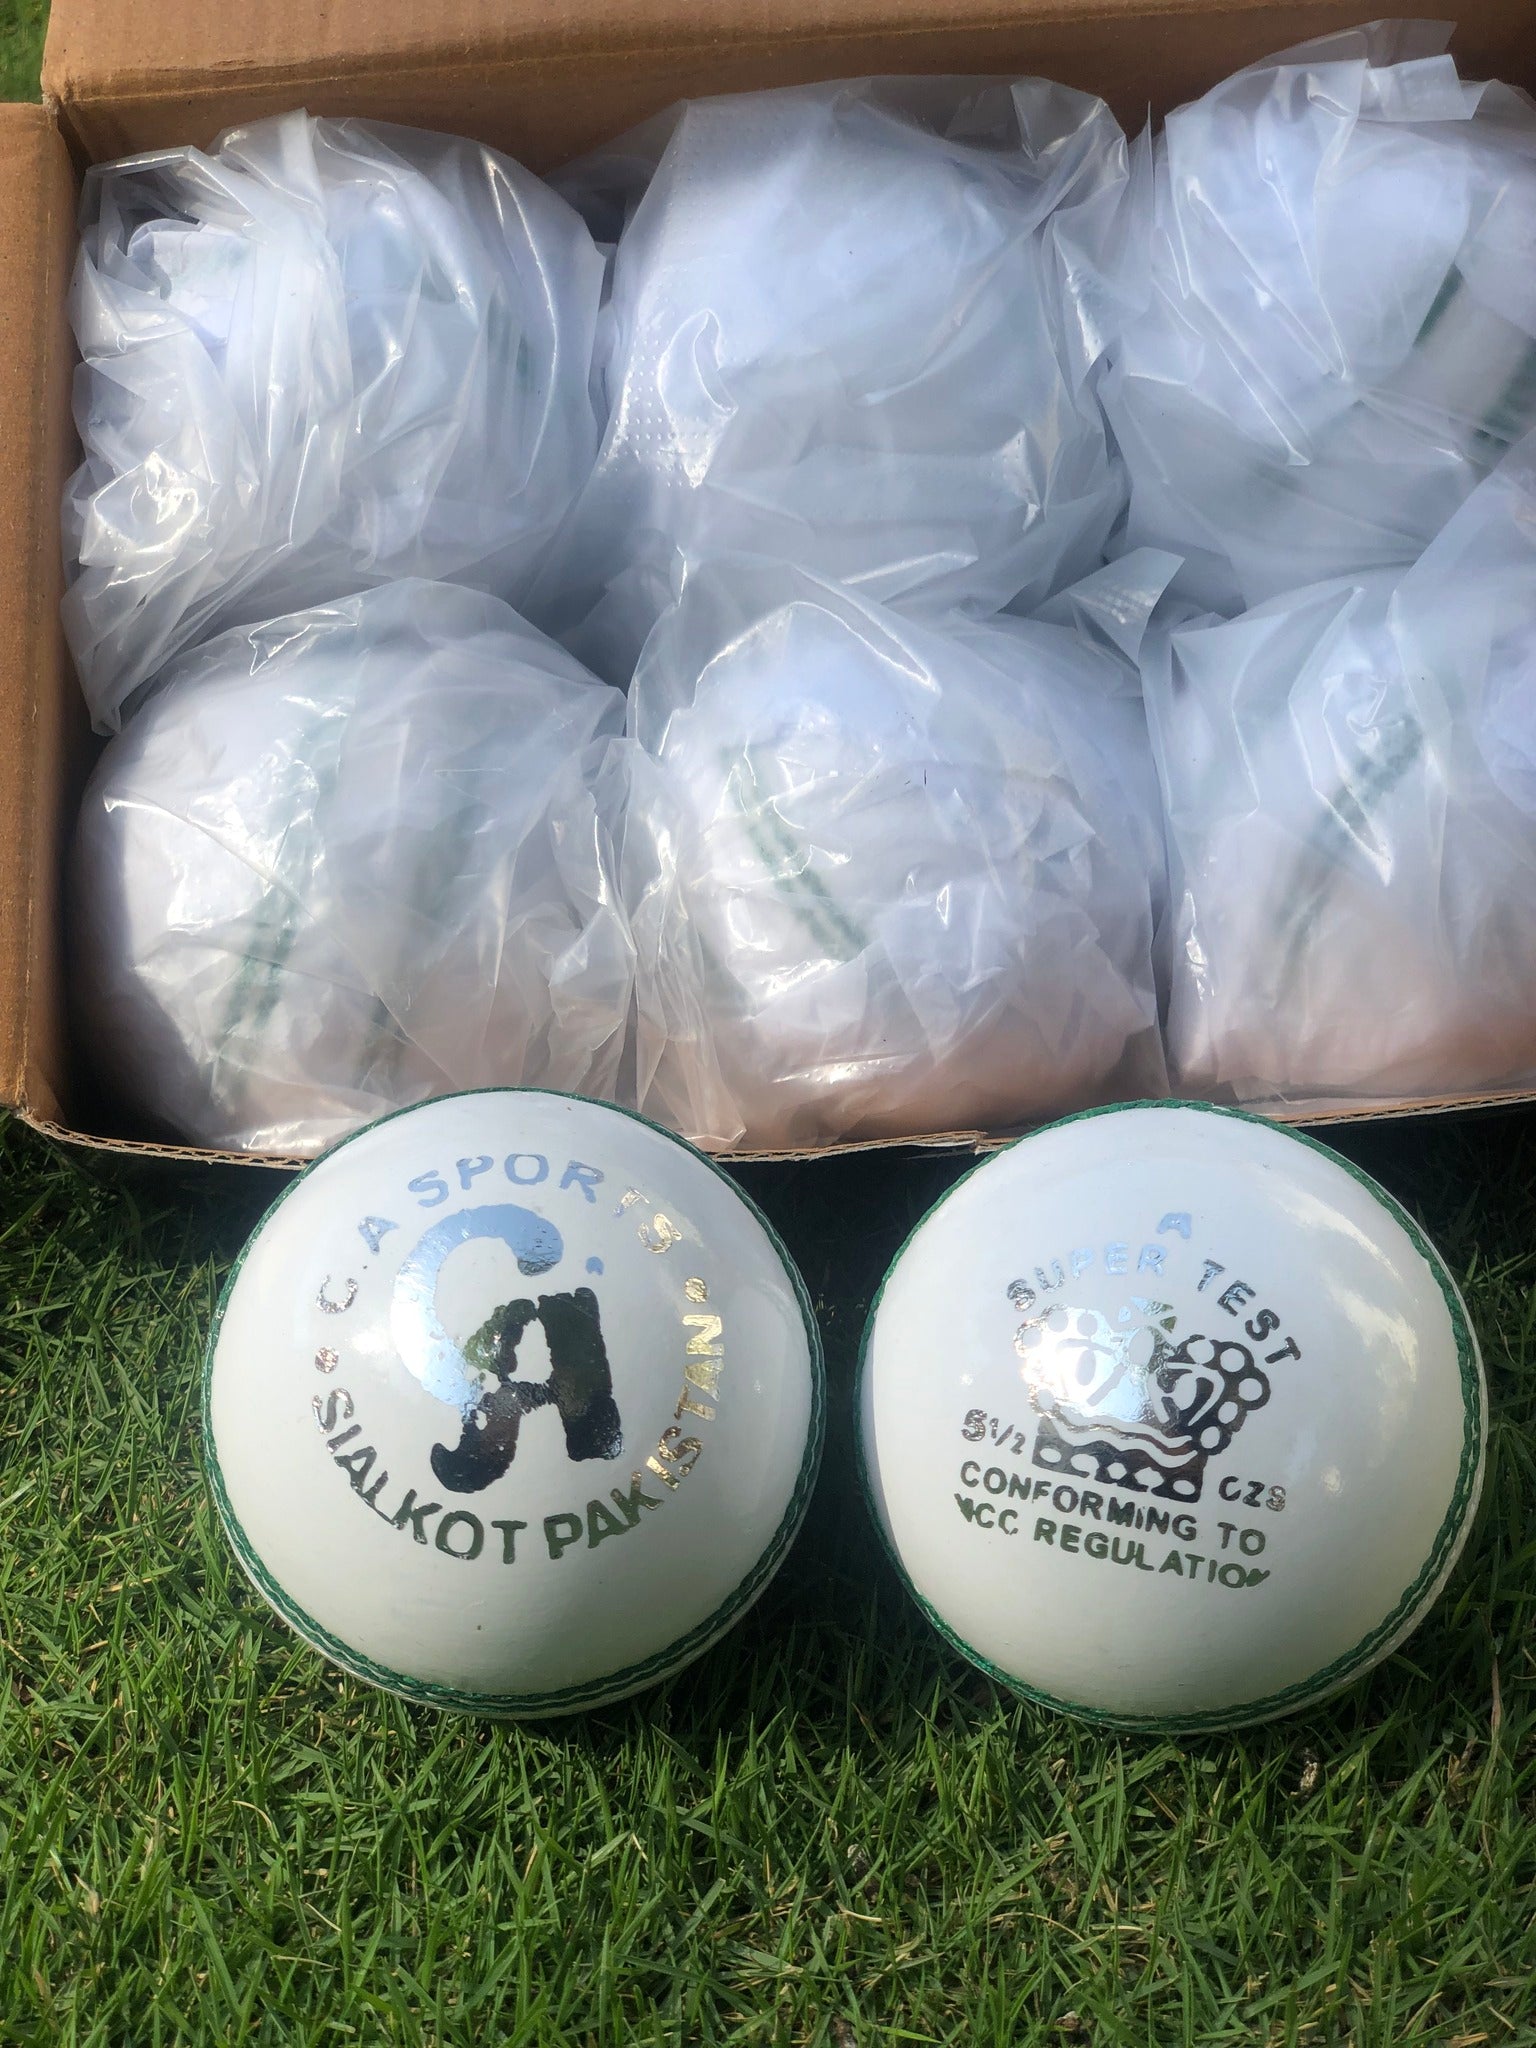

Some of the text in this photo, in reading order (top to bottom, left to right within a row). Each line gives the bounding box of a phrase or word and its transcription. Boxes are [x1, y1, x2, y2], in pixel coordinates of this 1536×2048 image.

[408, 1153, 682, 1254] SPORTS
[1157, 1212, 1192, 1240] A
[1006, 1242, 1302, 1365] SUPER TEST
[312, 1314, 725, 1564] SIALKOT PAKISTAN
[960, 1460, 1267, 1557] CONFORMING TO
